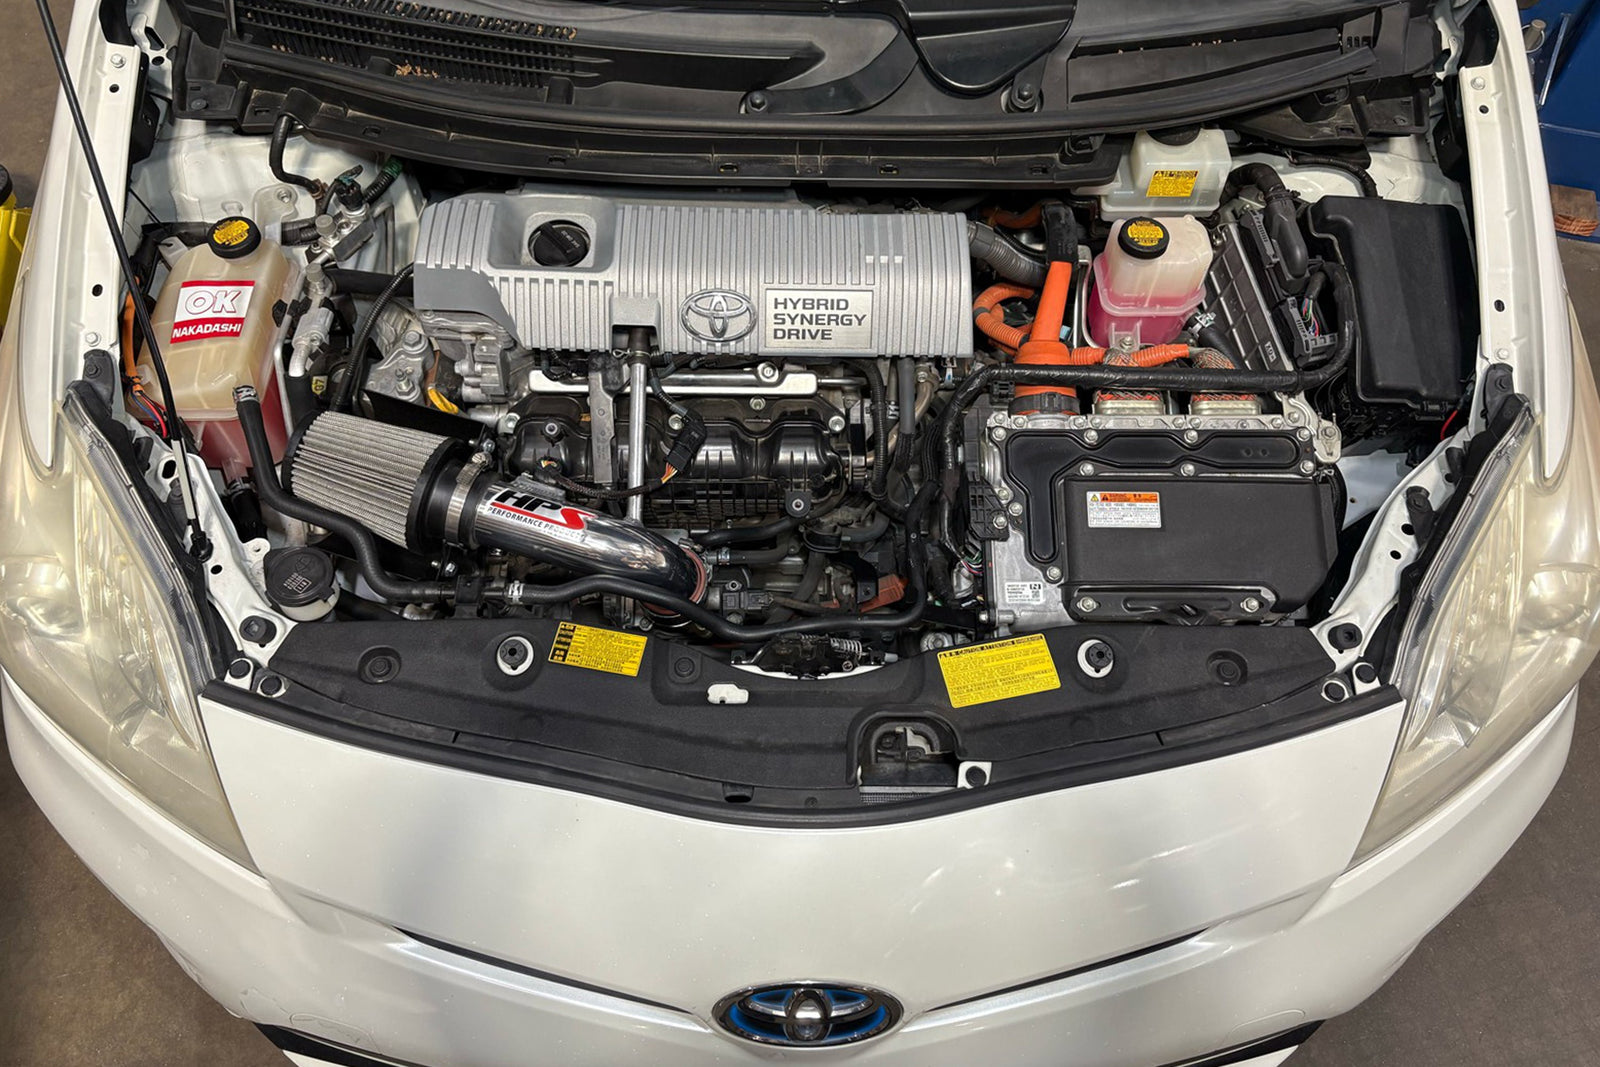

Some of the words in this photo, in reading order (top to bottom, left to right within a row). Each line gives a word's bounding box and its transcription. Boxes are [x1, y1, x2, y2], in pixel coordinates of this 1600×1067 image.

[185, 290, 242, 315] OK
[773, 297, 849, 311] HYBRID
[773, 313, 867, 326] SYNERGY
[172, 323, 242, 338] NAKADASHI
[773, 328, 833, 341] DRIVE
[488, 506, 542, 528] PERFORMANCE
[494, 489, 598, 530] HPS
